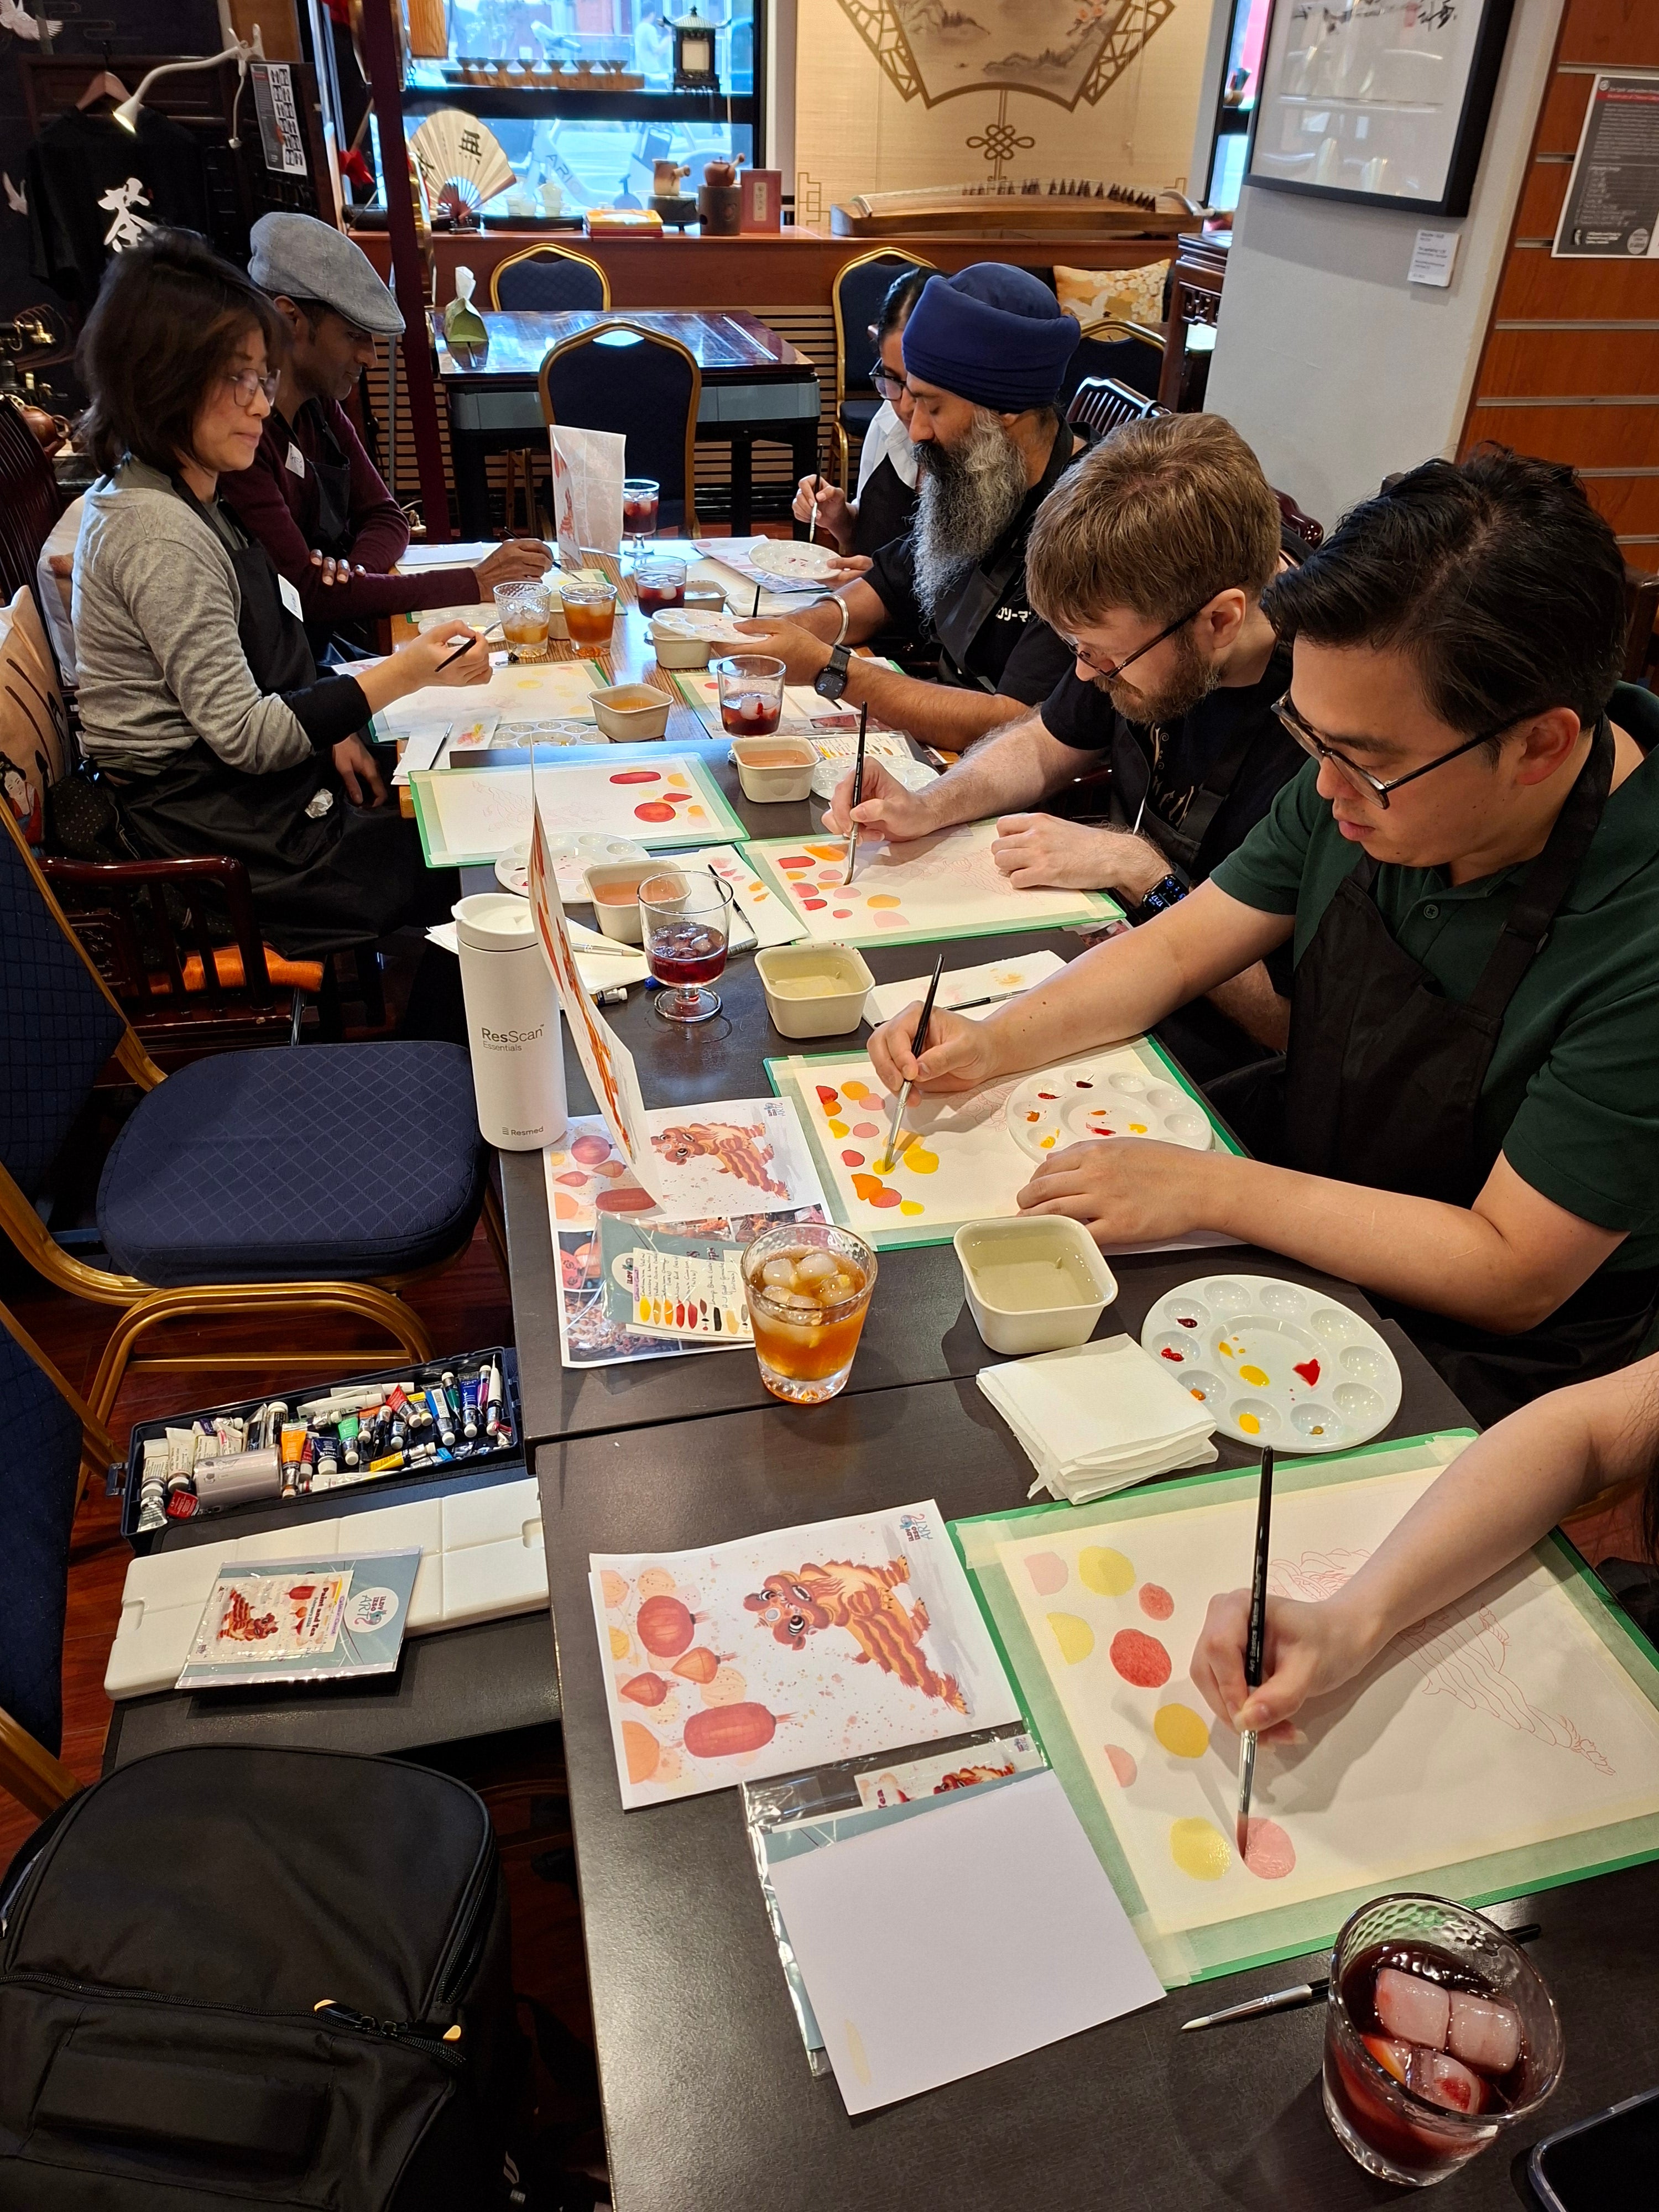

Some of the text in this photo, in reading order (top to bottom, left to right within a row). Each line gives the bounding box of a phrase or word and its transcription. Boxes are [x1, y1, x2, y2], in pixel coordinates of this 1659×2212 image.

[98, 177, 154, 253] 茶
[483, 1041, 522, 1052] Essentials
[511, 1126, 544, 1136] Resmed
[913, 1519, 933, 1540] ART
[318, 1587, 329, 1607] Paint
[357, 1595, 372, 1619] ART
[314, 1607, 322, 1623] and
[310, 1623, 319, 1637] Tea
[1249, 1630, 1258, 1657] Basics
